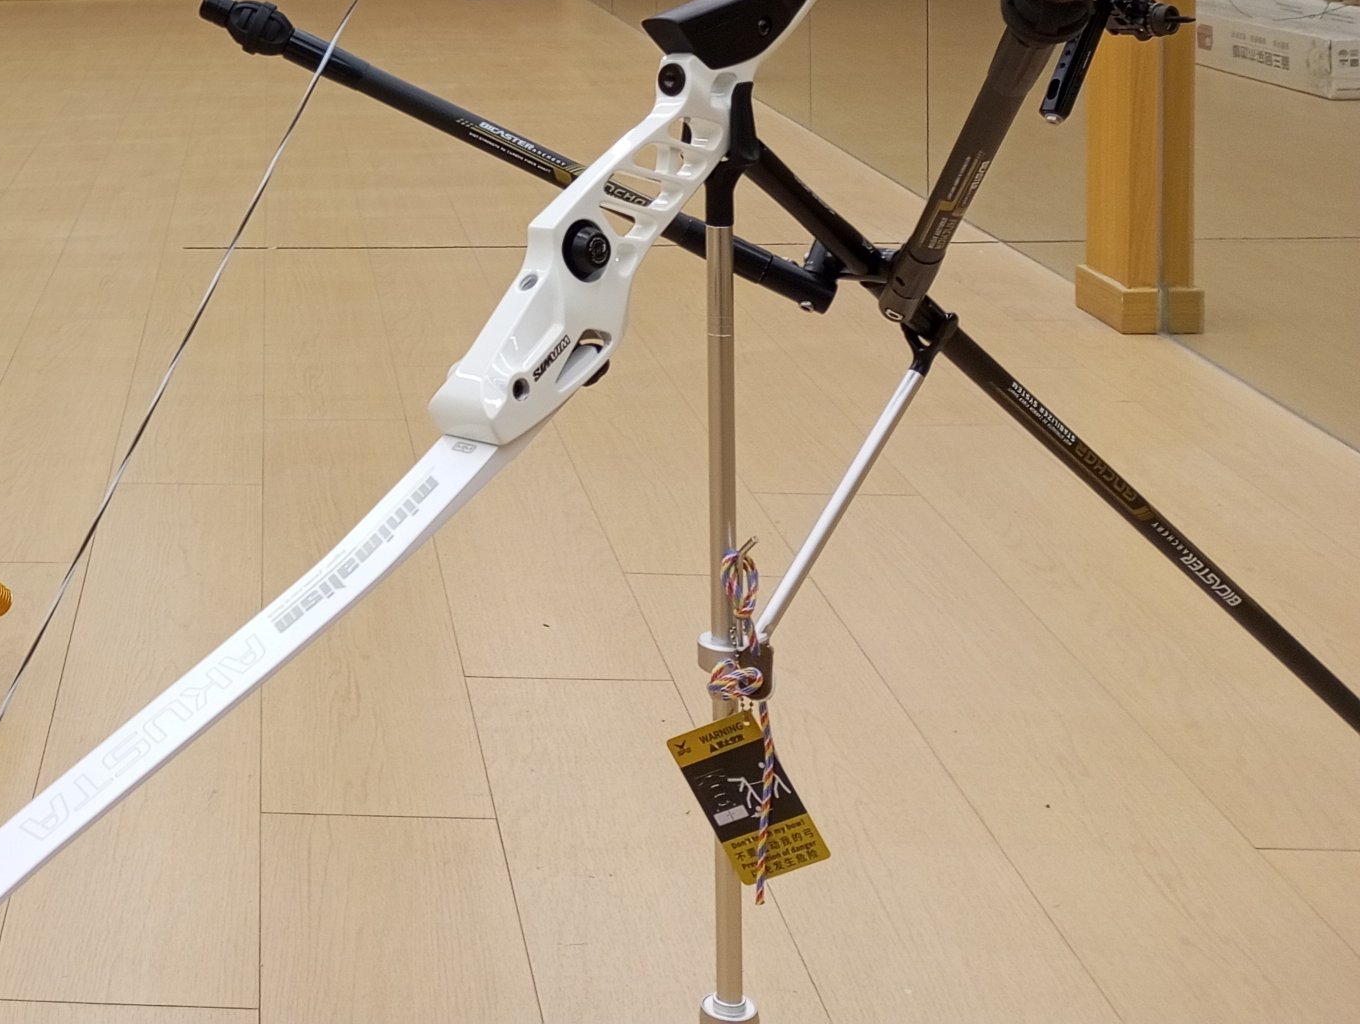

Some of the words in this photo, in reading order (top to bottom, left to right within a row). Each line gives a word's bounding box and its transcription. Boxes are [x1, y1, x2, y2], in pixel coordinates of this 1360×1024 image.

[479, 121, 535, 151] BICASTER
[1010, 381, 1039, 407] SYSTEM
[1041, 406, 1077, 443] STABILIZER
[273, 475, 440, 635] minimalism
[1151, 522, 1190, 556] ARCHERY
[1179, 553, 1242, 607] BICASTER
[20, 634, 268, 841] AKUSTA
[698, 721, 744, 744] WARNING
[773, 826, 786, 837] my
[785, 818, 806, 831] bow!
[735, 828, 814, 861] 不要动我的弓
[782, 847, 791, 856] of
[790, 840, 817, 854] danger
